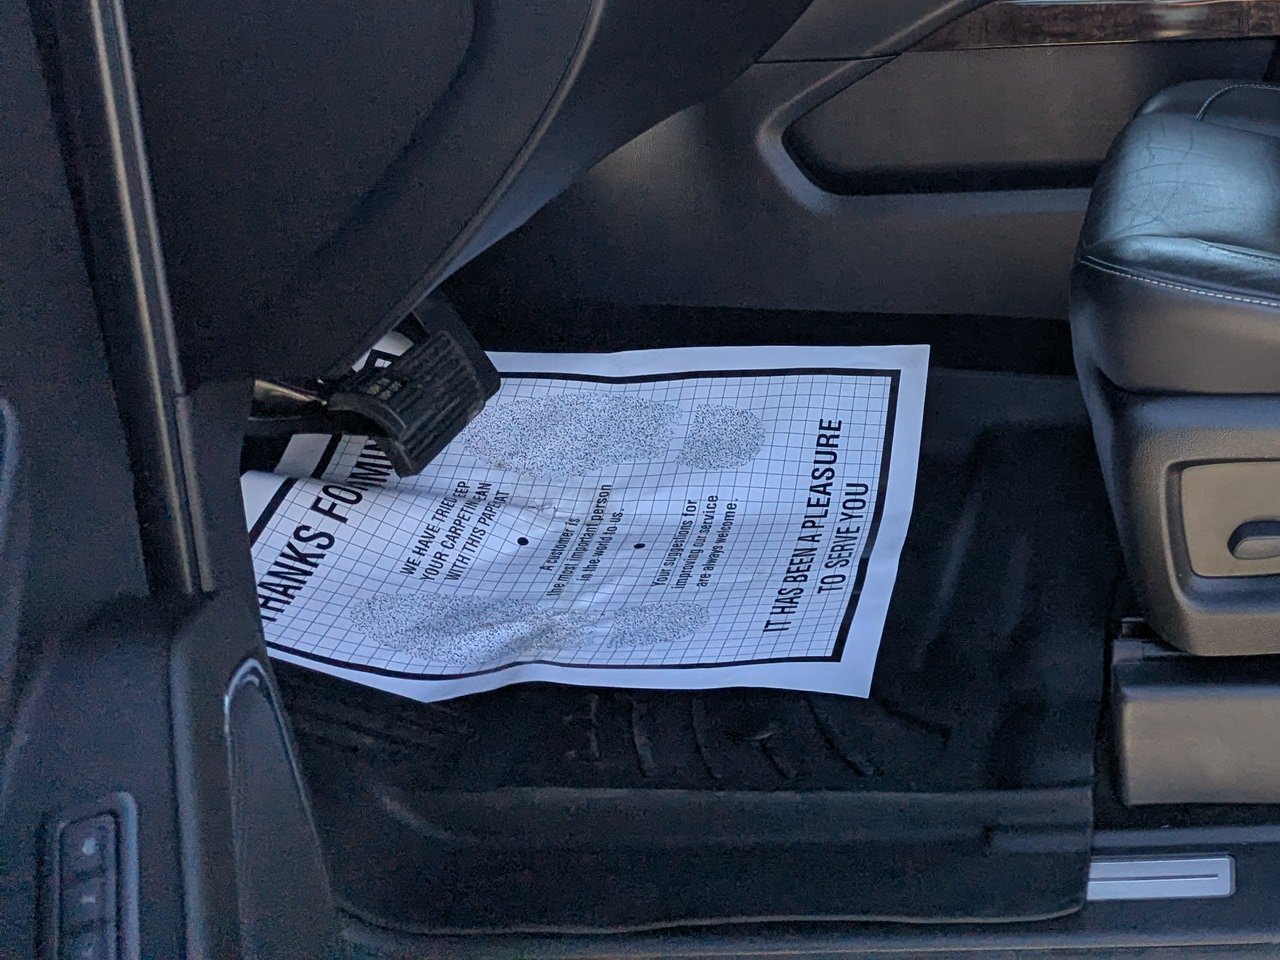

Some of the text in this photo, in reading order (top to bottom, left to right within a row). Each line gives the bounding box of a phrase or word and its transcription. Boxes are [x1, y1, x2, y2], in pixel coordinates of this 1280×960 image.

[311, 485, 367, 524] FO
[400, 557, 421, 575] WE
[411, 524, 440, 557] HAVE
[452, 480, 471, 497] EEP
[419, 552, 449, 581] YOUR
[440, 501, 478, 550] CARPETIN
[545, 528, 574, 564] customer
[565, 518, 580, 527] is
[546, 484, 611, 596] the most important person
[577, 508, 624, 582] in the world to us.
[651, 499, 697, 587] Your suggestions for
[671, 495, 718, 589] improving our service
[696, 498, 738, 587] are always welcome.
[763, 418, 842, 633] IT HAS BEEN A PLEASURE
[817, 482, 870, 594] TO SERVE YOU
[445, 554, 471, 581] WITH
[461, 527, 486, 552] THIS
